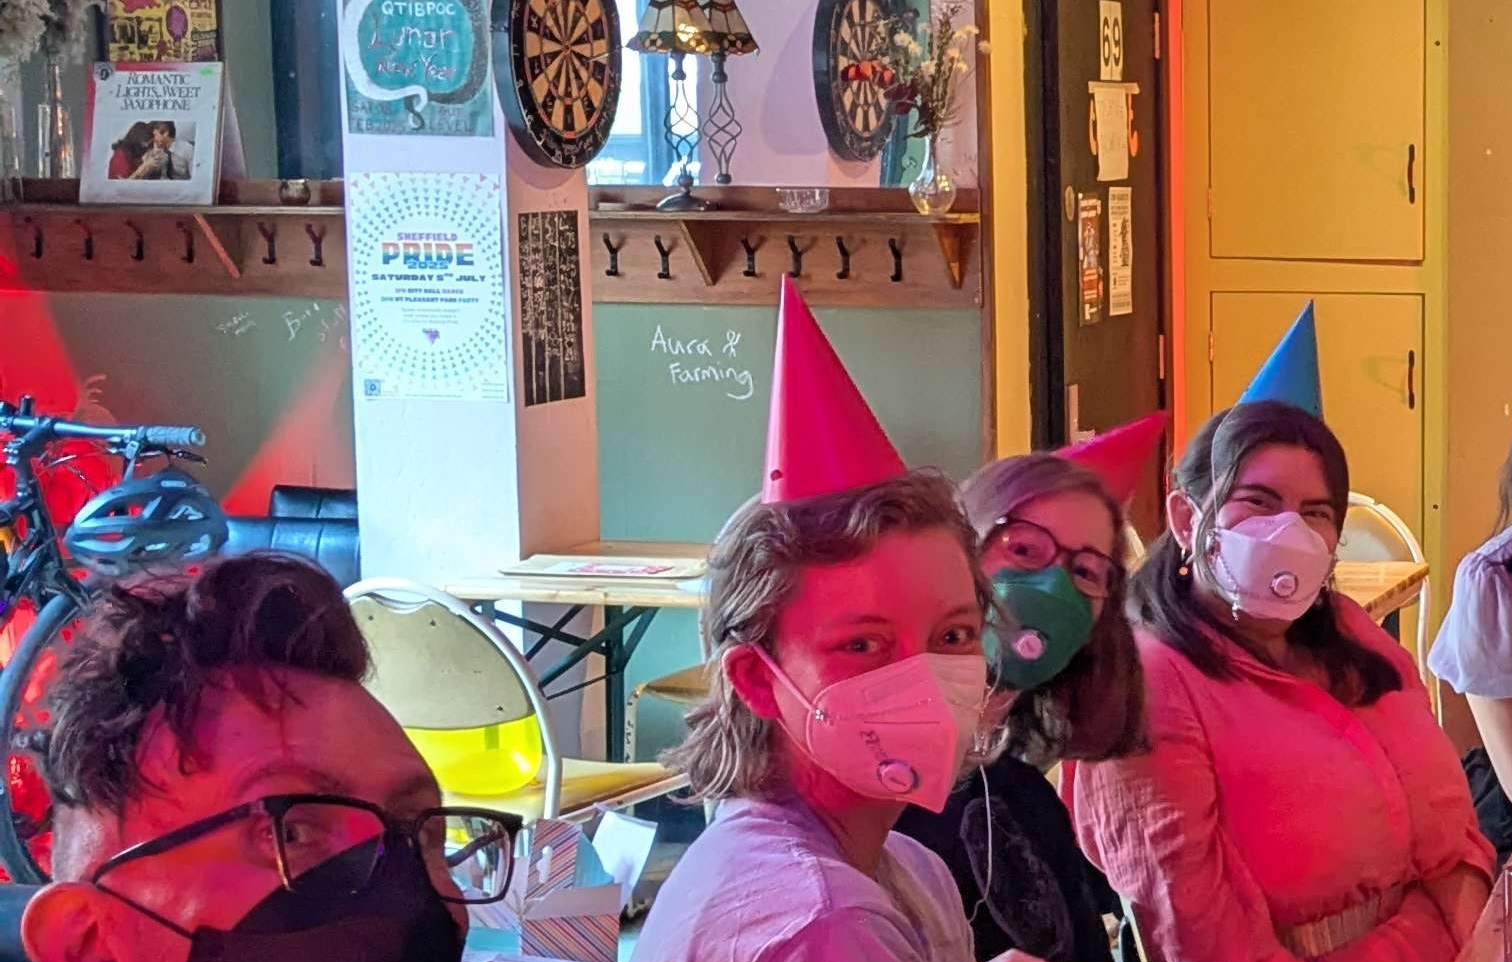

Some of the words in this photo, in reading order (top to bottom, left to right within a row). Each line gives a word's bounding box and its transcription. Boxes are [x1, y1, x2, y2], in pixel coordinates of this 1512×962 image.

[381, 1, 457, 17] QTIBPOC
[1102, 16, 1121, 67] 69
[127, 72, 191, 85] ROMANTIC
[381, 242, 475, 266] PRIDE
[371, 273, 434, 281] SATURDAY
[455, 274, 486, 283] JULY
[651, 324, 713, 356] Aura
[668, 360, 753, 400] Farming
